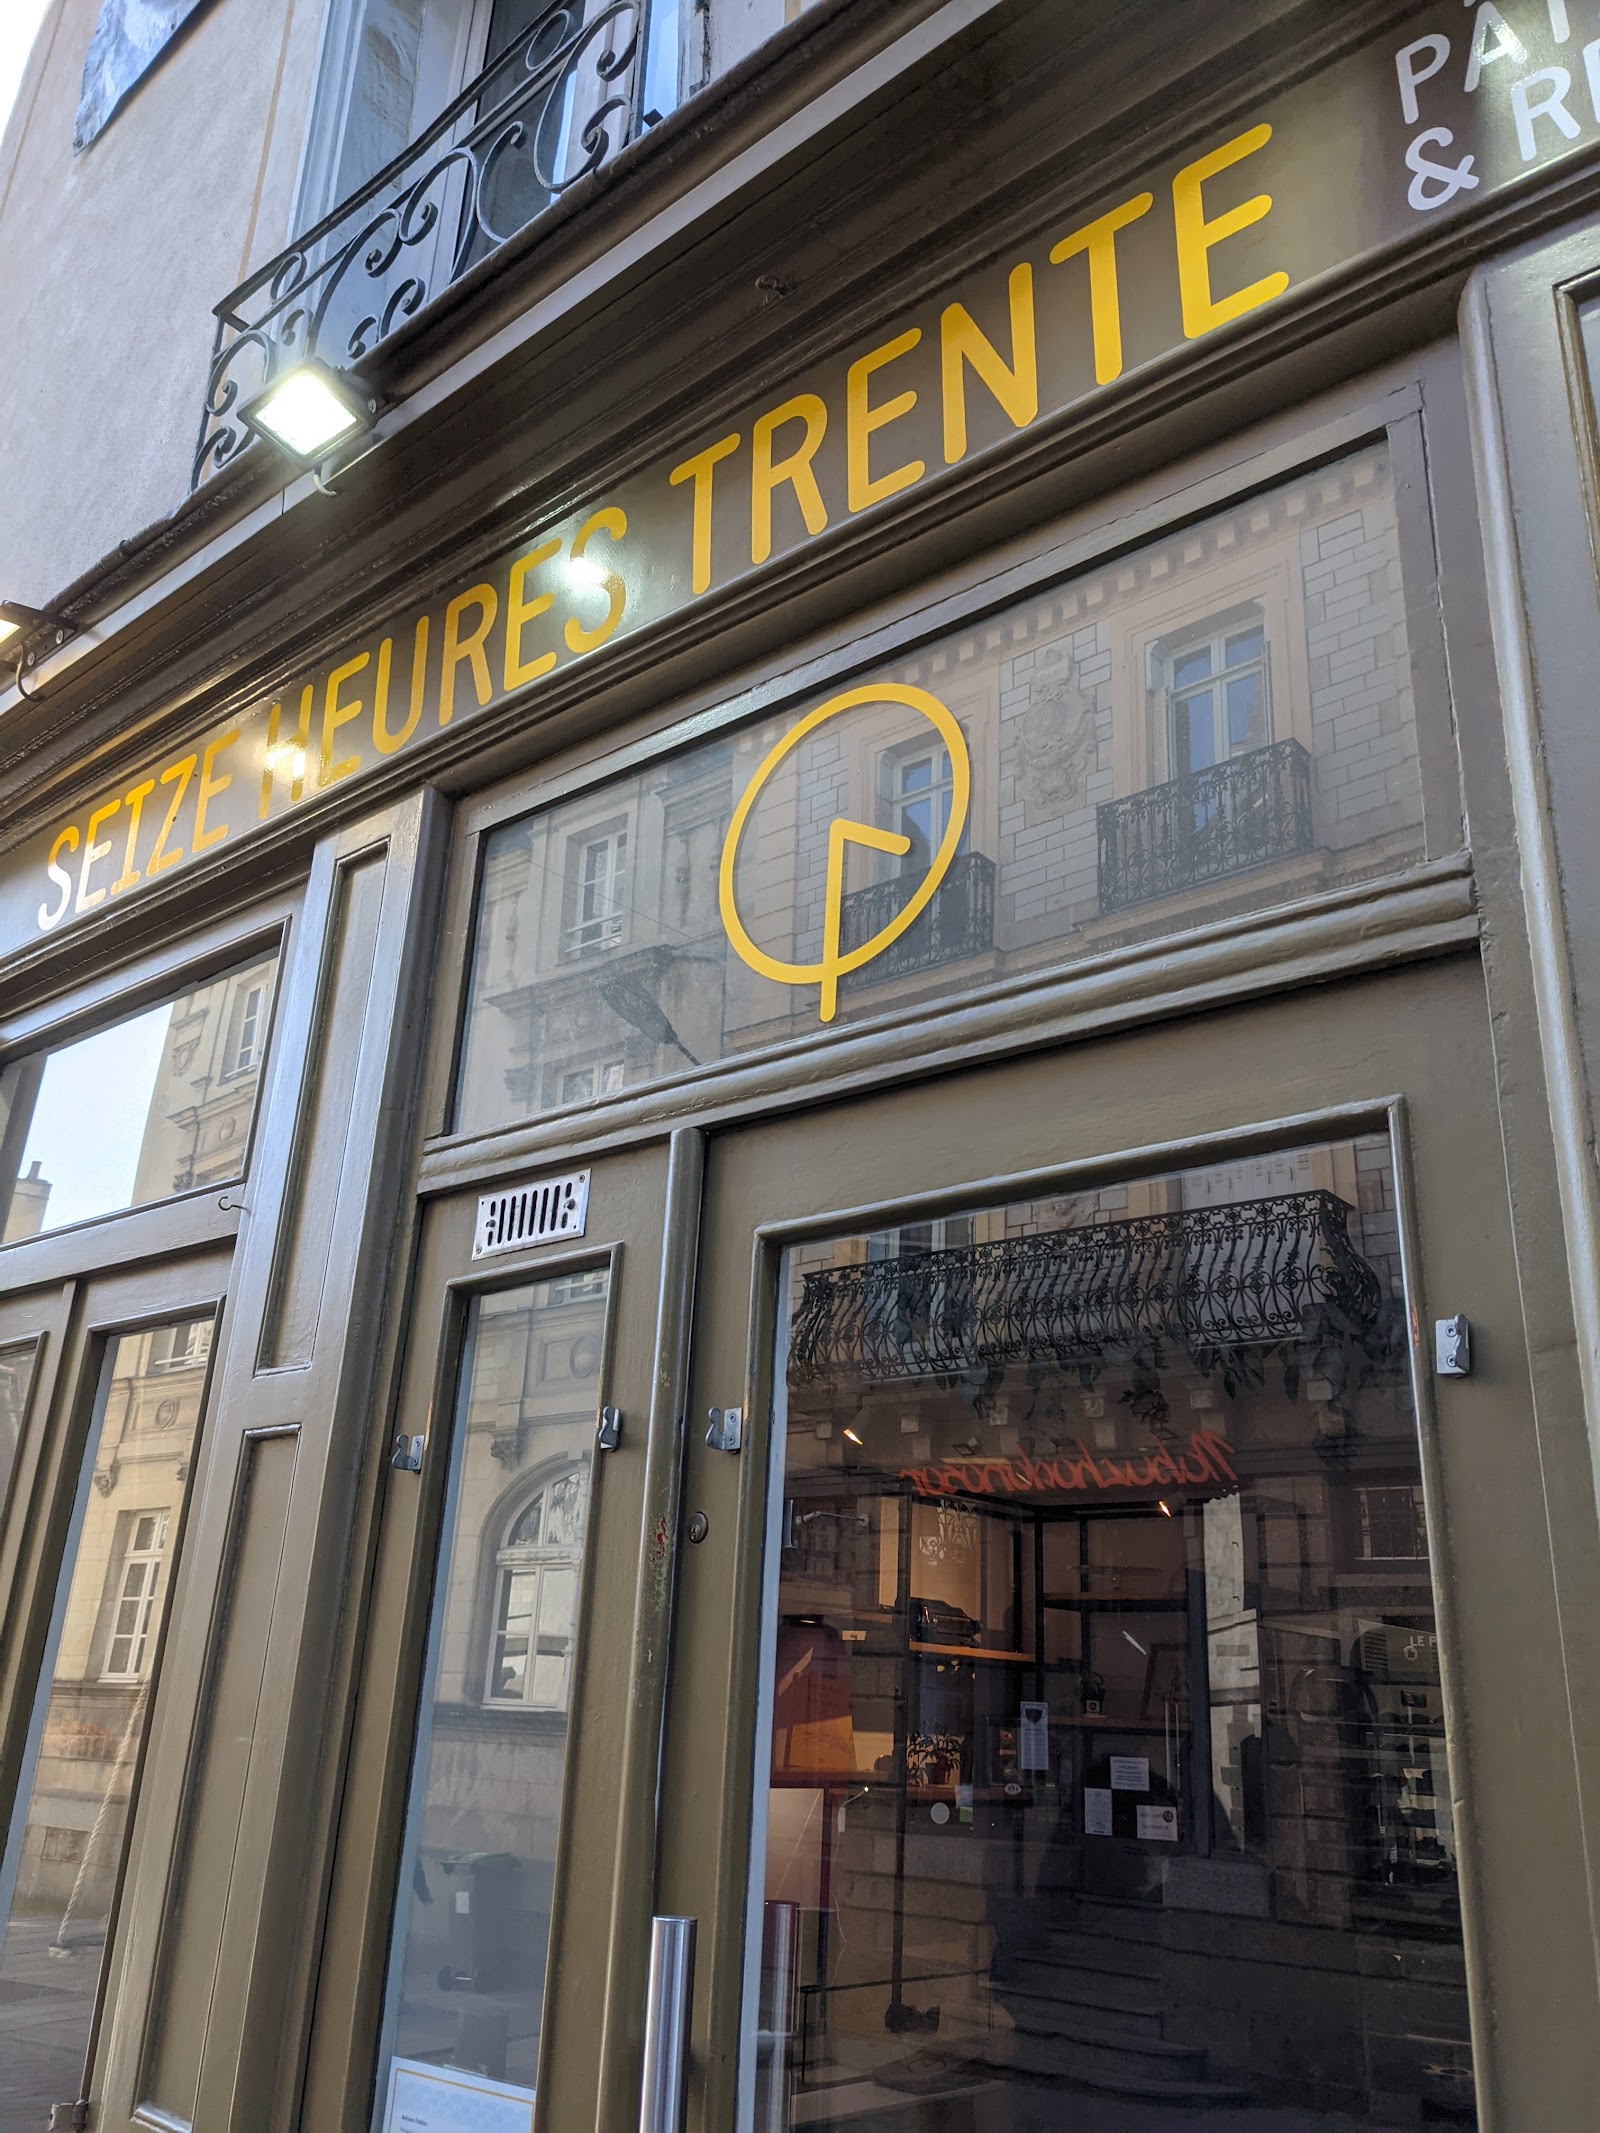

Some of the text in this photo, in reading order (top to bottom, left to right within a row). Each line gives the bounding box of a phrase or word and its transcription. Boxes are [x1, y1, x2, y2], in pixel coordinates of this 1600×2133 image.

[1405, 126, 1480, 211] &
[37, 123, 1290, 932] SEIZE HEURES TRENTE
[1409, 1635, 1425, 1647] LE
